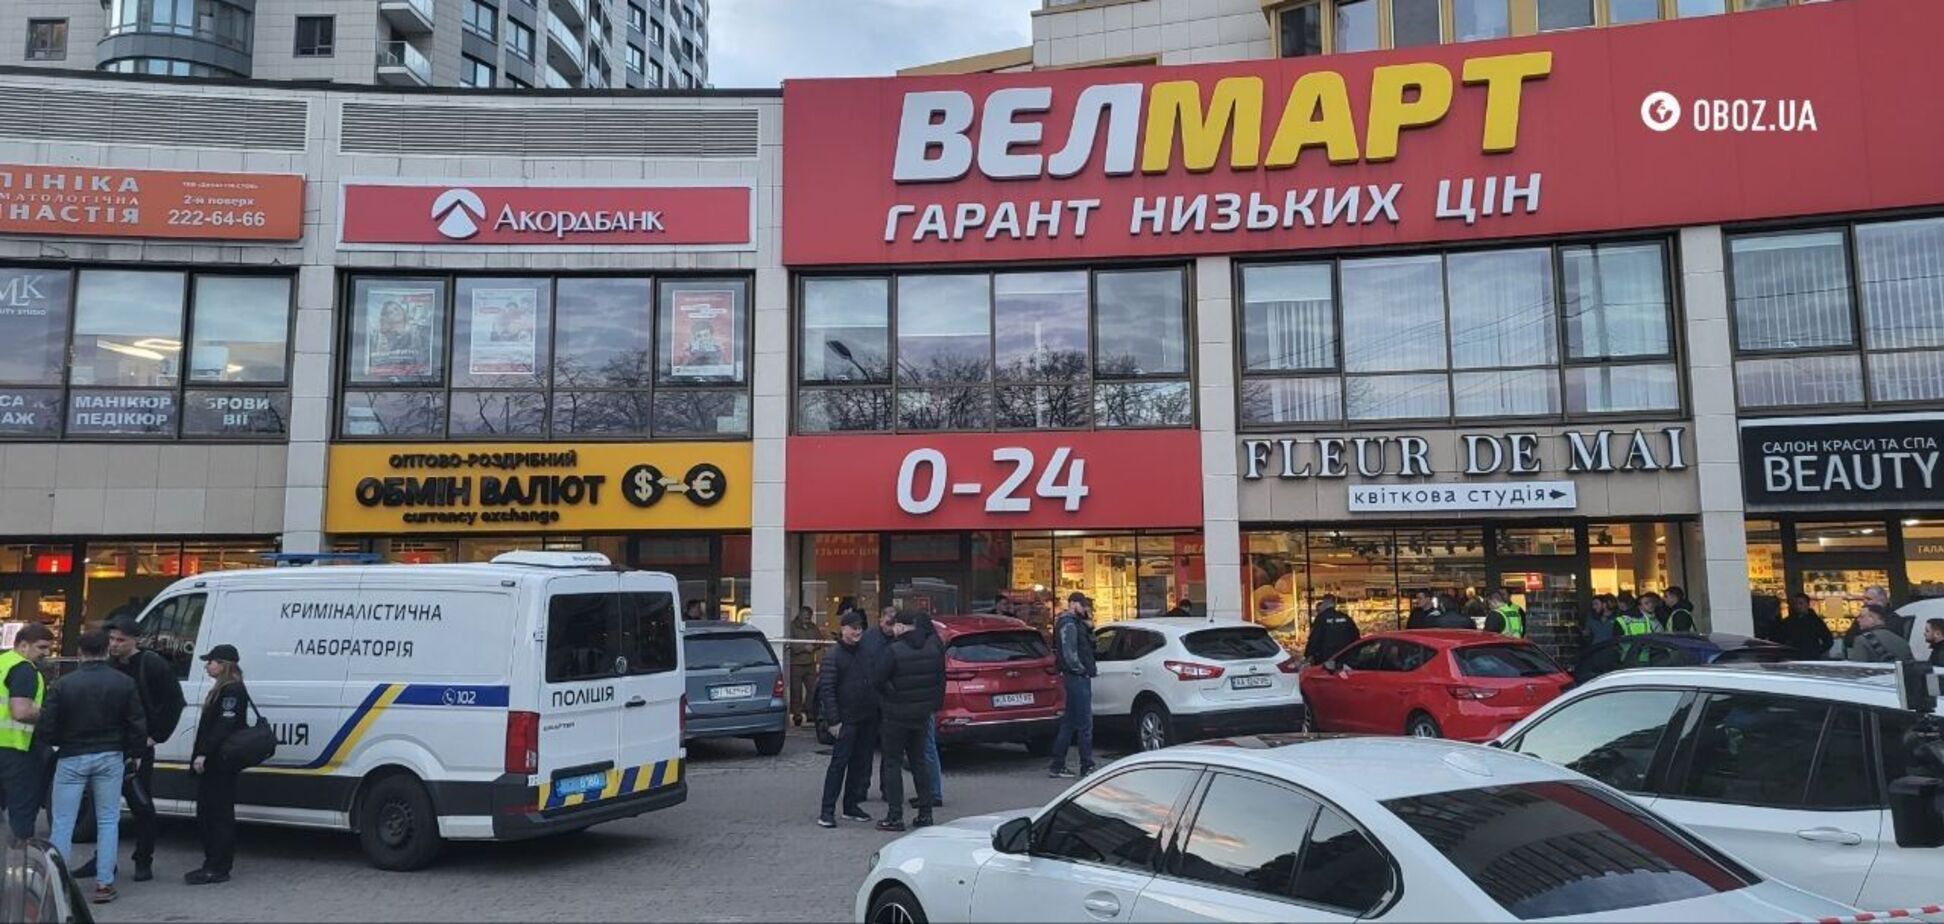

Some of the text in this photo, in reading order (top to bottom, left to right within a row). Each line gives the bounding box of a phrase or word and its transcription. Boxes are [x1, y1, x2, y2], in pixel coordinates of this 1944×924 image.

[893, 51, 1552, 184] ВЕЛМАРТ
[0, 203, 139, 224] НАСТІЯ
[884, 172, 1542, 242] ГАРАНТ НИЗЬКИХ ЦІН
[168, 209, 266, 227] 222-64-66
[75, 395, 171, 410] МАНІКЮР
[76, 412, 169, 426] ПЕДІКЮР
[1242, 426, 1688, 481] FLEUR DE MAI
[1762, 436, 1938, 454] САЛОН КРАСИ ТА СПА
[388, 450, 578, 470] ОПТОВО-РОЗДРІБНИЙ
[896, 447, 1089, 515] 0-24
[1763, 451, 1940, 492] BEAUTY
[356, 475, 606, 508] ОБМІН ВАЛЮТ
[1354, 484, 1546, 507] квіткова студія
[402, 508, 560, 526] currency exchange
[280, 602, 443, 621] КРИМІНАЛІСТИЧНА
[294, 639, 414, 658] ЛАБОРАТОРІЯ
[456, 690, 477, 705] 102
[552, 685, 615, 708] ПОЛІЦІЯ
